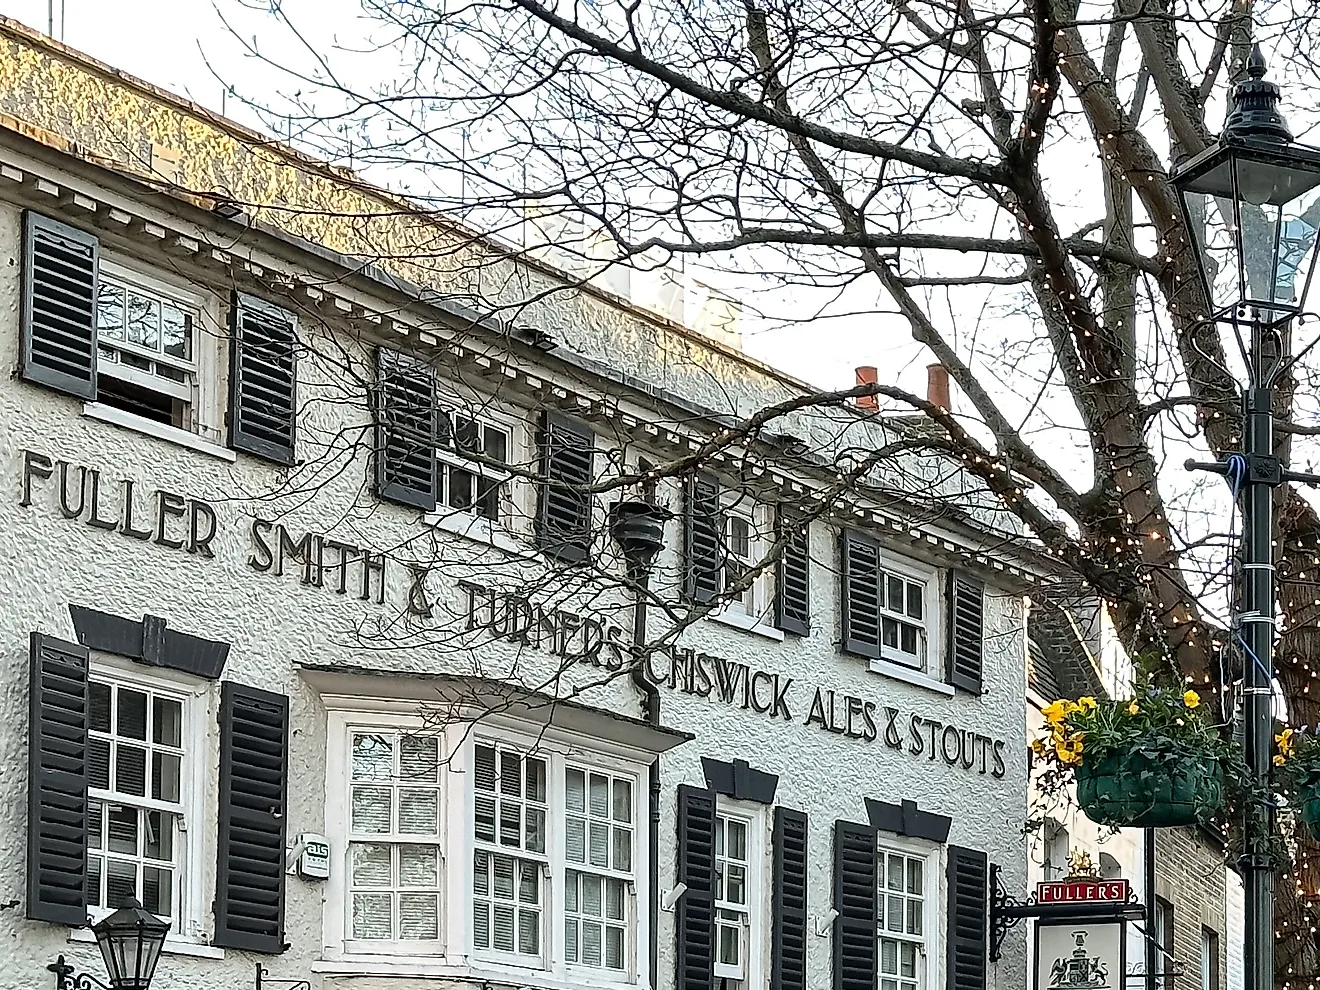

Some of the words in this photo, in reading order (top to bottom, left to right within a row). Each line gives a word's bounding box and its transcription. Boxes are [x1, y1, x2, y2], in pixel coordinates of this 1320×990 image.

[19, 448, 217, 559] FULLER
[247, 519, 387, 606] SMITH
[407, 562, 434, 619] &
[802, 685, 879, 743] ALES
[882, 706, 904, 751] &
[908, 713, 1007, 780] STOUTS
[1041, 884, 1120, 900] FULLER'S
